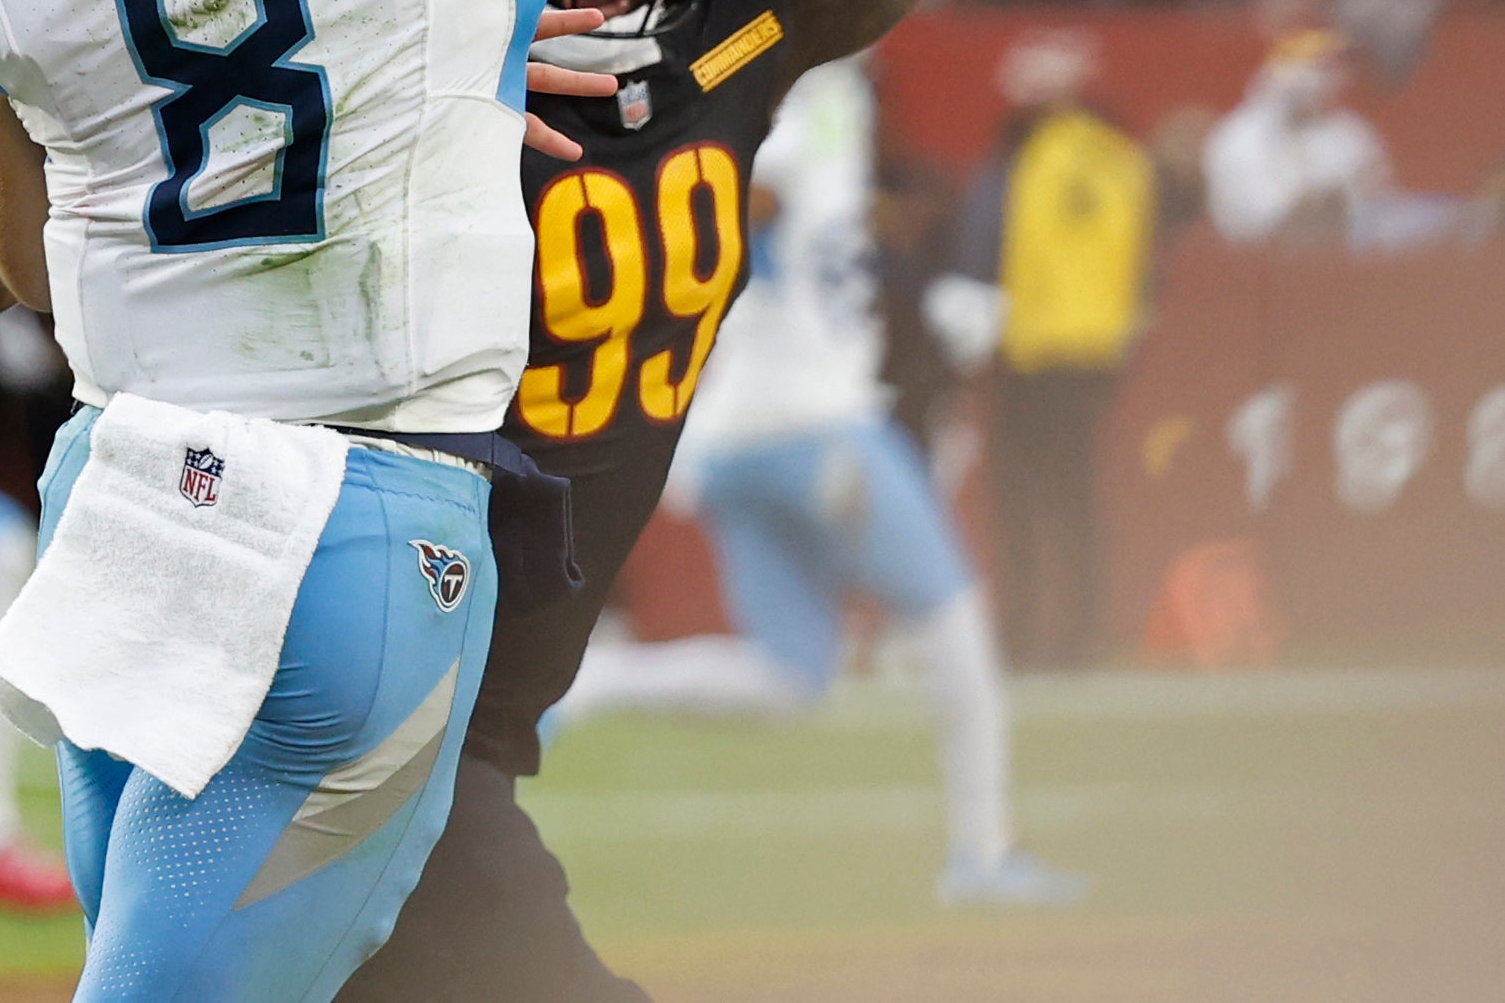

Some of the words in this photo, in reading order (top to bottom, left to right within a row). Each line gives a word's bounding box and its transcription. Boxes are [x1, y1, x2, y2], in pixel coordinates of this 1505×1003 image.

[694, 16, 782, 86] COMMANDERS
[517, 141, 743, 442] 99
[182, 468, 217, 501] NFL
[444, 574, 463, 601] T
